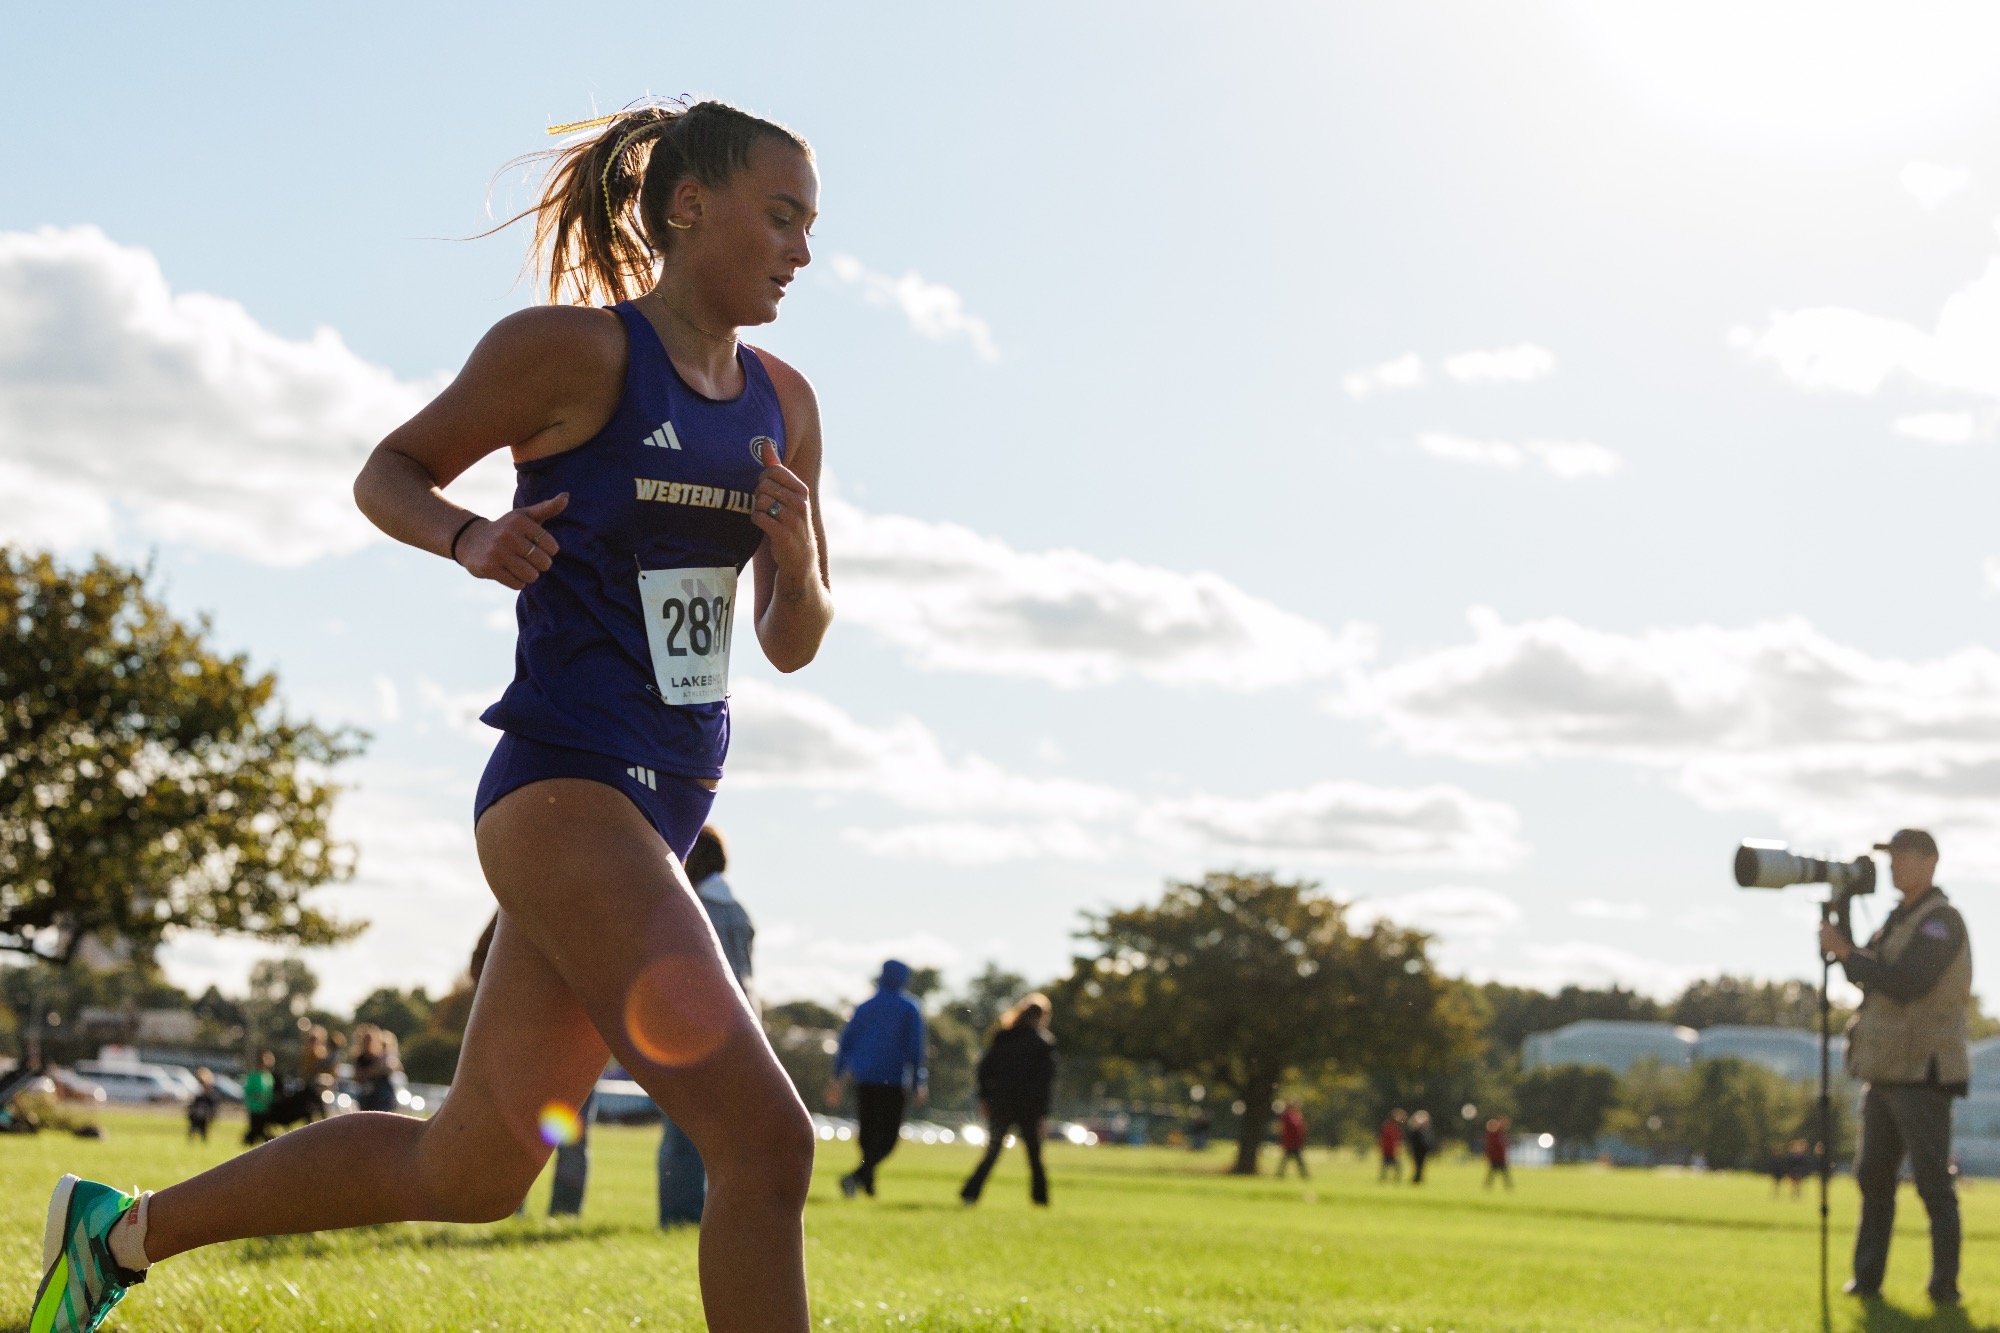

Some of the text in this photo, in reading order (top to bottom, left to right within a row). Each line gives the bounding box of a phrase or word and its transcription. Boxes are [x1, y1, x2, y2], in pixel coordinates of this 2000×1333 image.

[634, 477, 725, 510] WESTERN
[662, 596, 732, 657] 2881
[671, 674, 726, 688] LAKES
